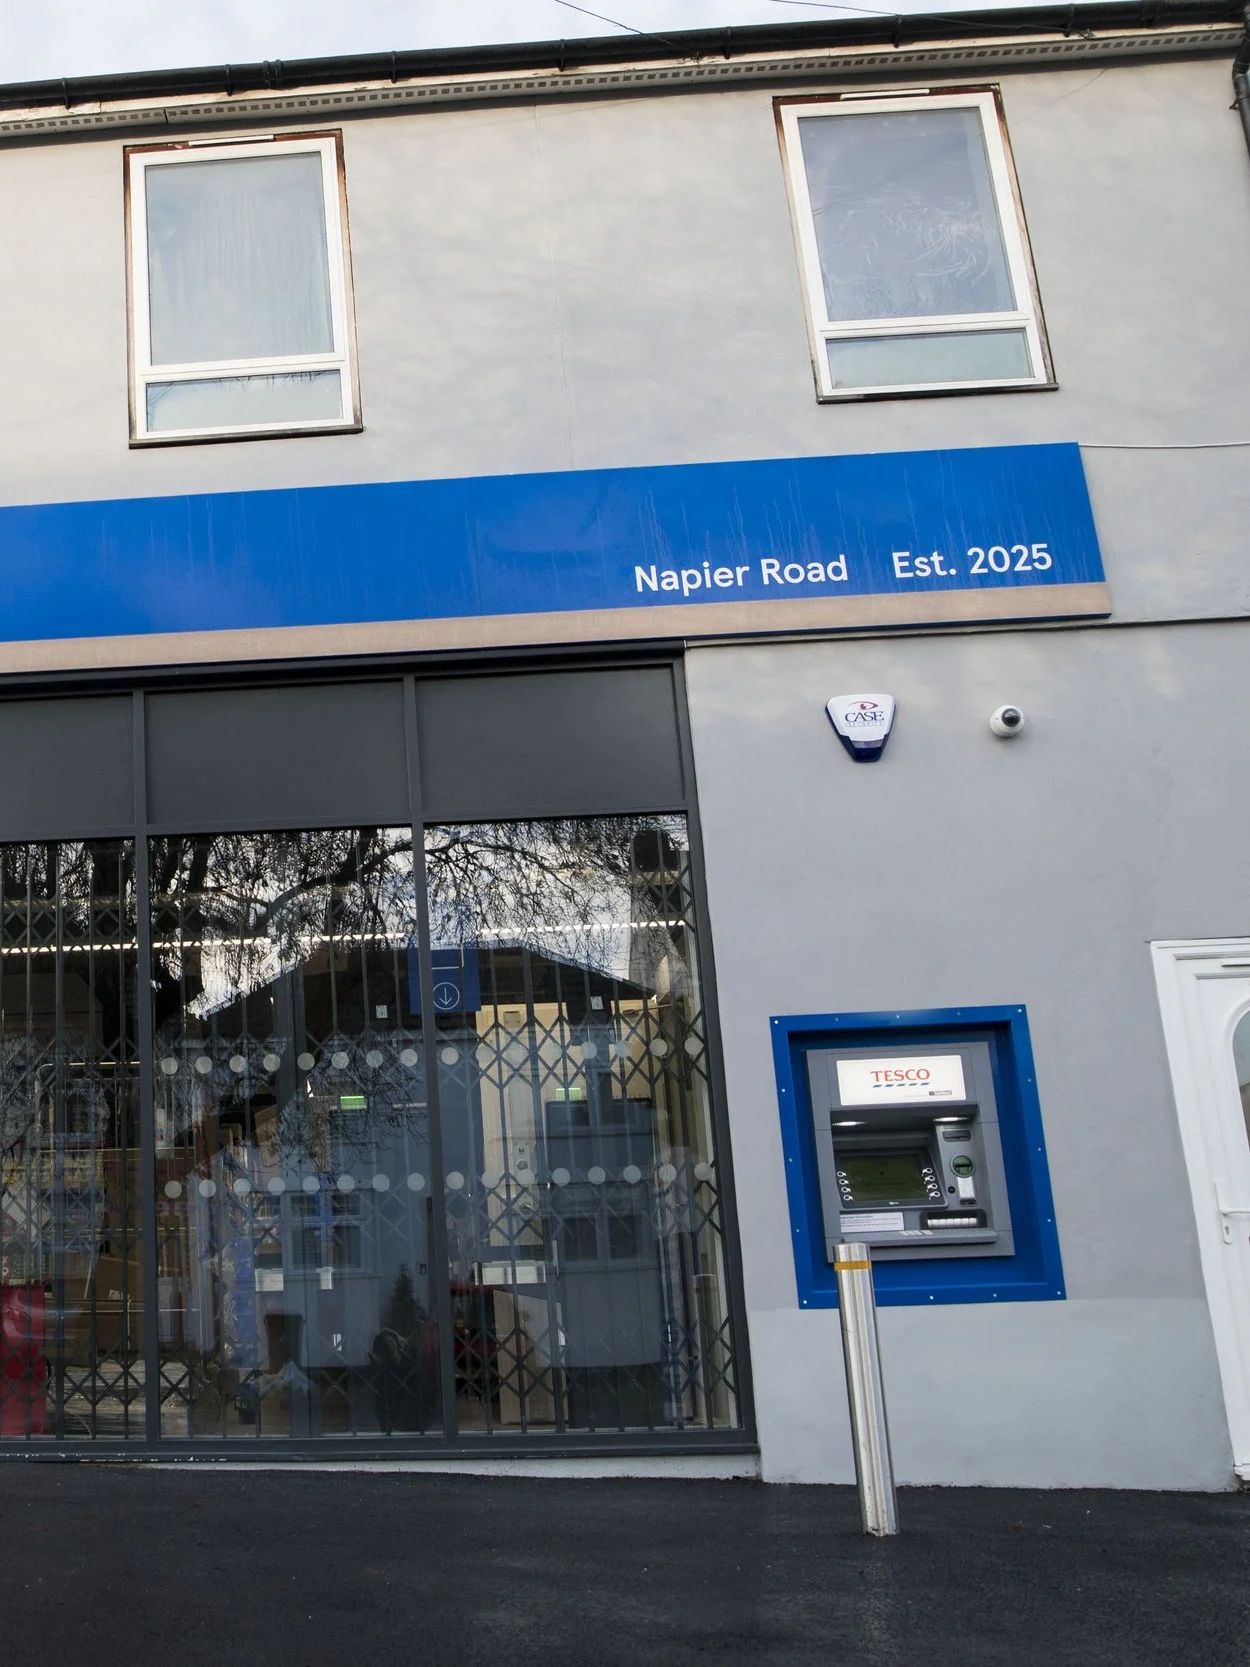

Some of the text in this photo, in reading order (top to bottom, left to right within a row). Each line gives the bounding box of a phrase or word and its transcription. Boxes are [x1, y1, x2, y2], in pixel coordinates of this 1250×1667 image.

[634, 543, 1052, 597] Napier Road Est. 2025
[844, 711, 885, 722] CASE
[870, 1068, 931, 1083] TESCO
